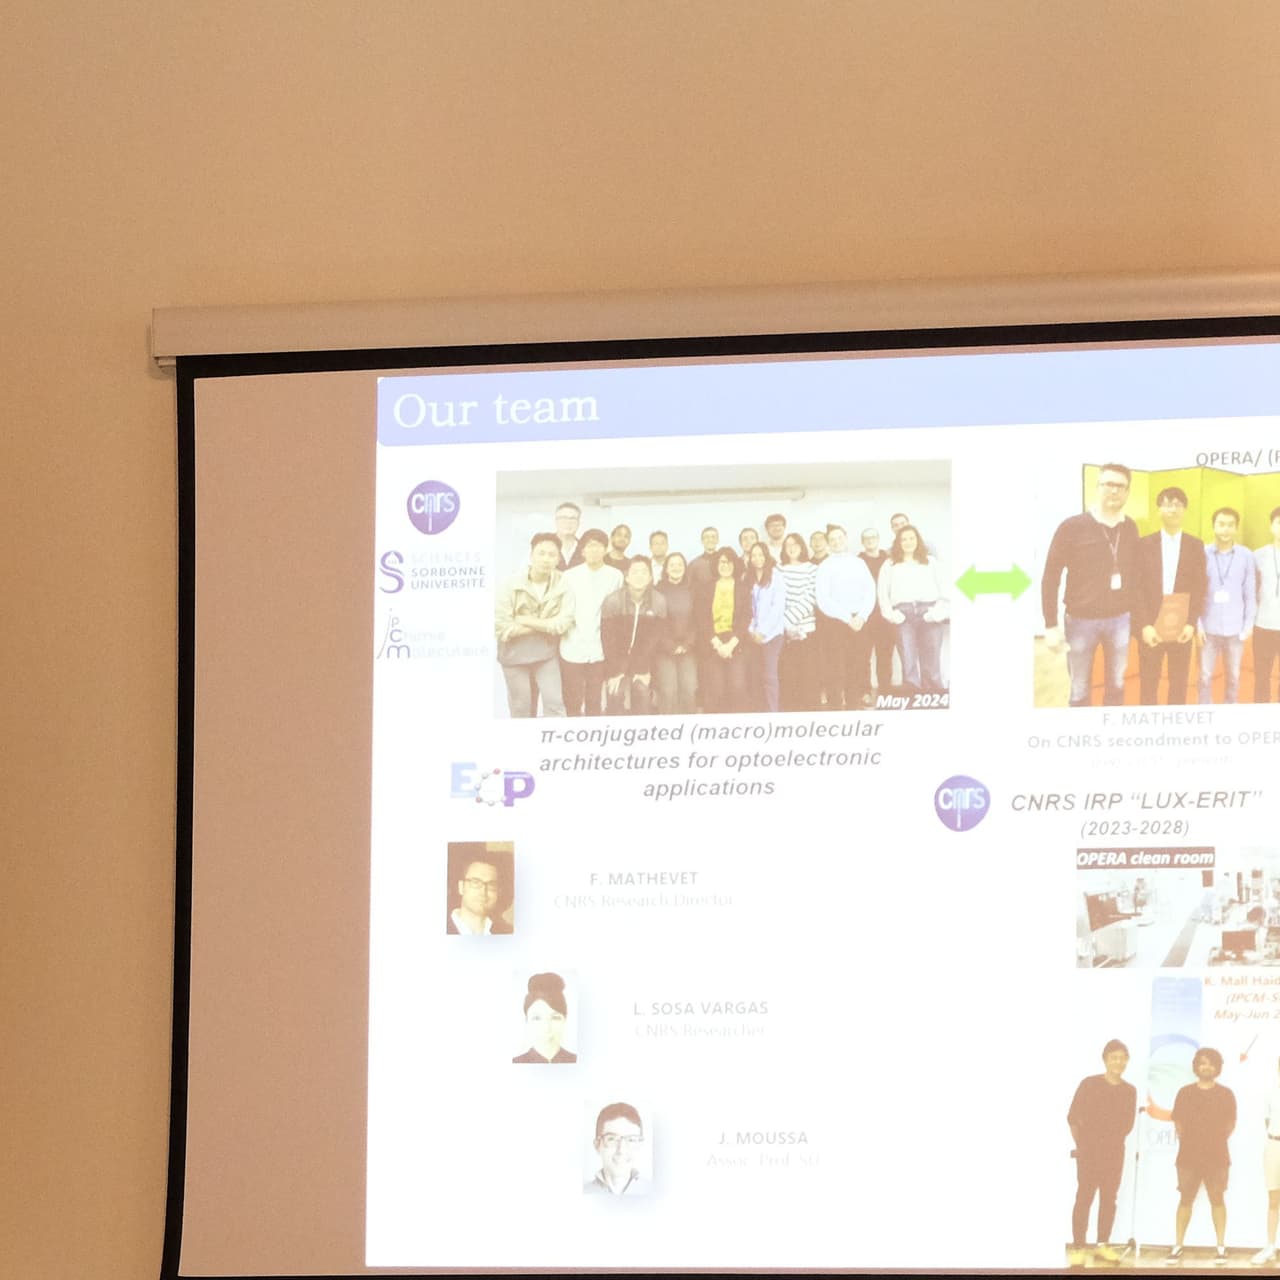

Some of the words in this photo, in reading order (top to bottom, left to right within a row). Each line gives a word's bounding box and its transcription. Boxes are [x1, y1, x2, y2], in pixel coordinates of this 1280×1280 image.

[393, 392, 479, 428] Our
[493, 391, 601, 425] team
[1196, 449, 1263, 468] OPERA/
[411, 565, 487, 578] SORBONNE
[876, 695, 910, 712] May
[912, 692, 950, 709] 2024
[1122, 710, 1217, 726] MATHEVET
[690, 719, 884, 745] (macro)molecular
[1027, 734, 1051, 749] On
[1056, 734, 1103, 748] CNRS
[1108, 732, 1209, 748] secondment
[1215, 732, 1232, 746] to
[539, 750, 681, 772] architectures
[689, 749, 717, 769] for
[724, 747, 882, 773] optoelectronic
[643, 777, 776, 801] applications
[1010, 793, 1077, 812] CNRS
[1084, 792, 1124, 811] IRP
[1080, 819, 1191, 840] (2023-2028)
[1076, 851, 1127, 866] OPERA
[1130, 850, 1171, 866] clean
[1174, 851, 1214, 865] room
[608, 871, 699, 886] MATHEVET
[634, 1000, 646, 1017] L.
[652, 1001, 696, 1016] SOSA
[700, 1000, 770, 1016] VARGAS
[717, 1131, 730, 1146] J.
[736, 1130, 810, 1146] MOUSSA
